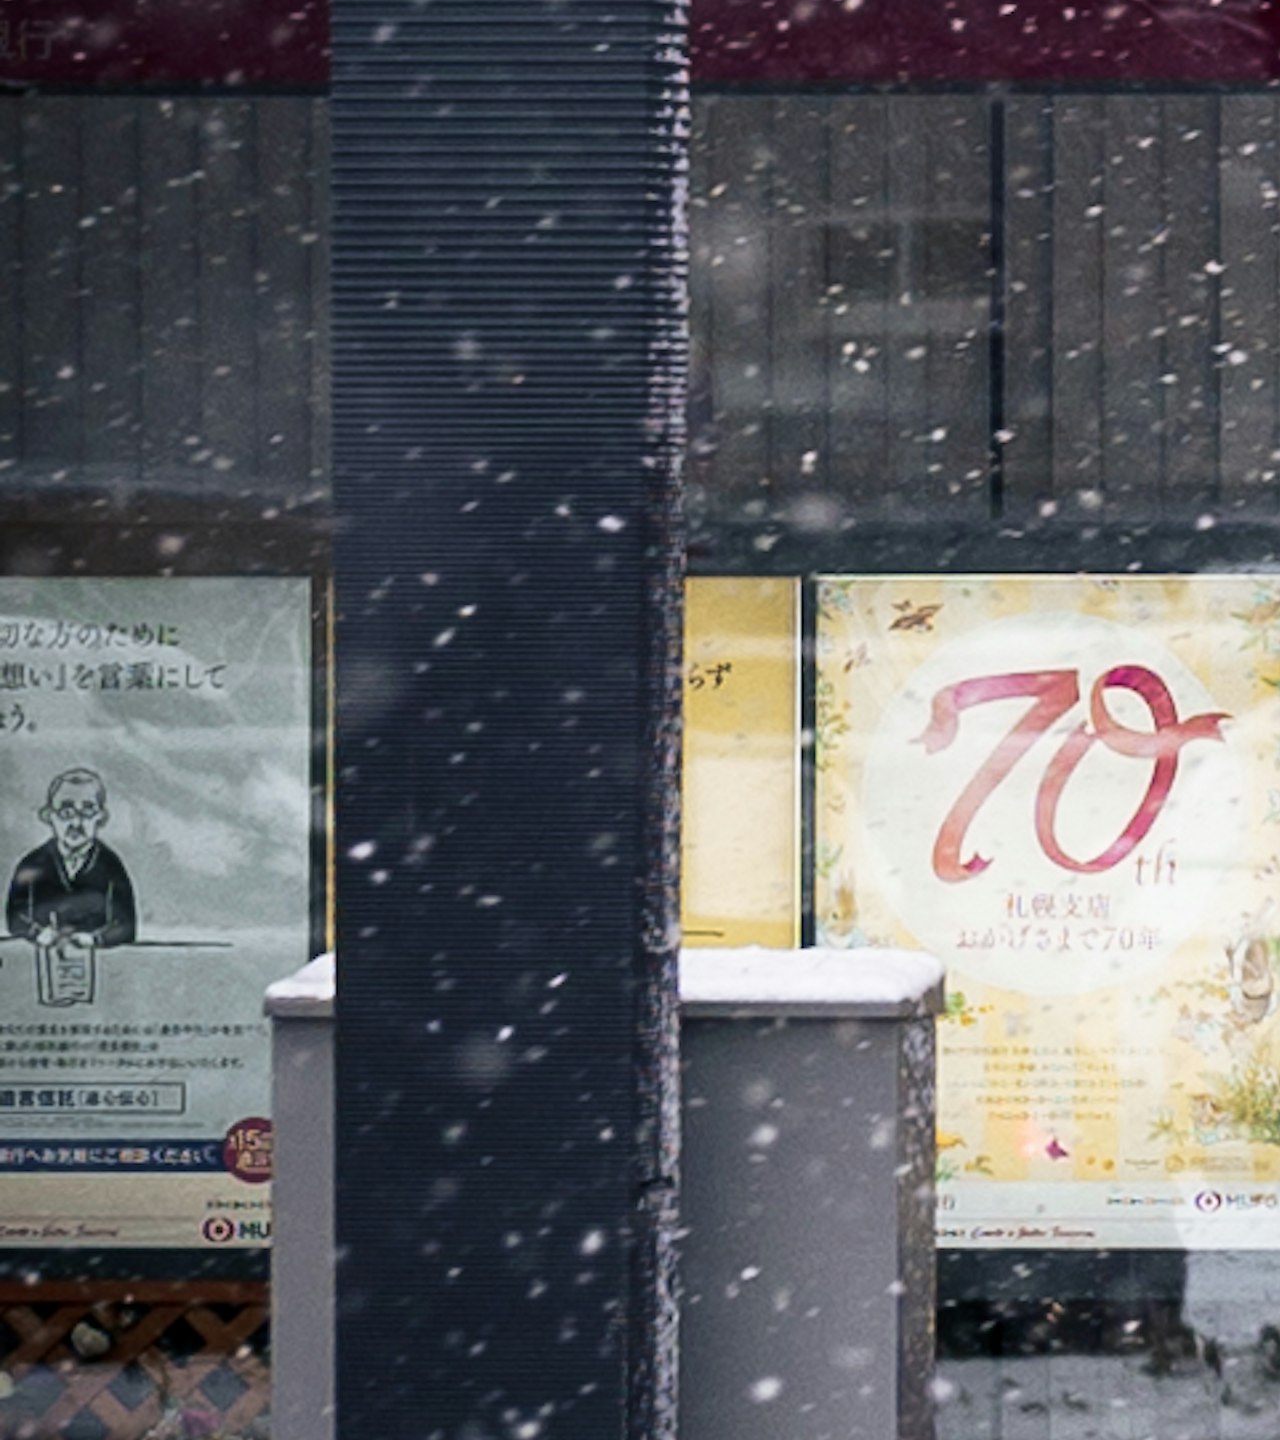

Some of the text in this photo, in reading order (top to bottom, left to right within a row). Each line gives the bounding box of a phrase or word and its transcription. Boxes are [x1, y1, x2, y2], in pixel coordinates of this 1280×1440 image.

[1006, 893, 1110, 919] 札幌支店
[1225, 1192, 1278, 1212] MUFG
